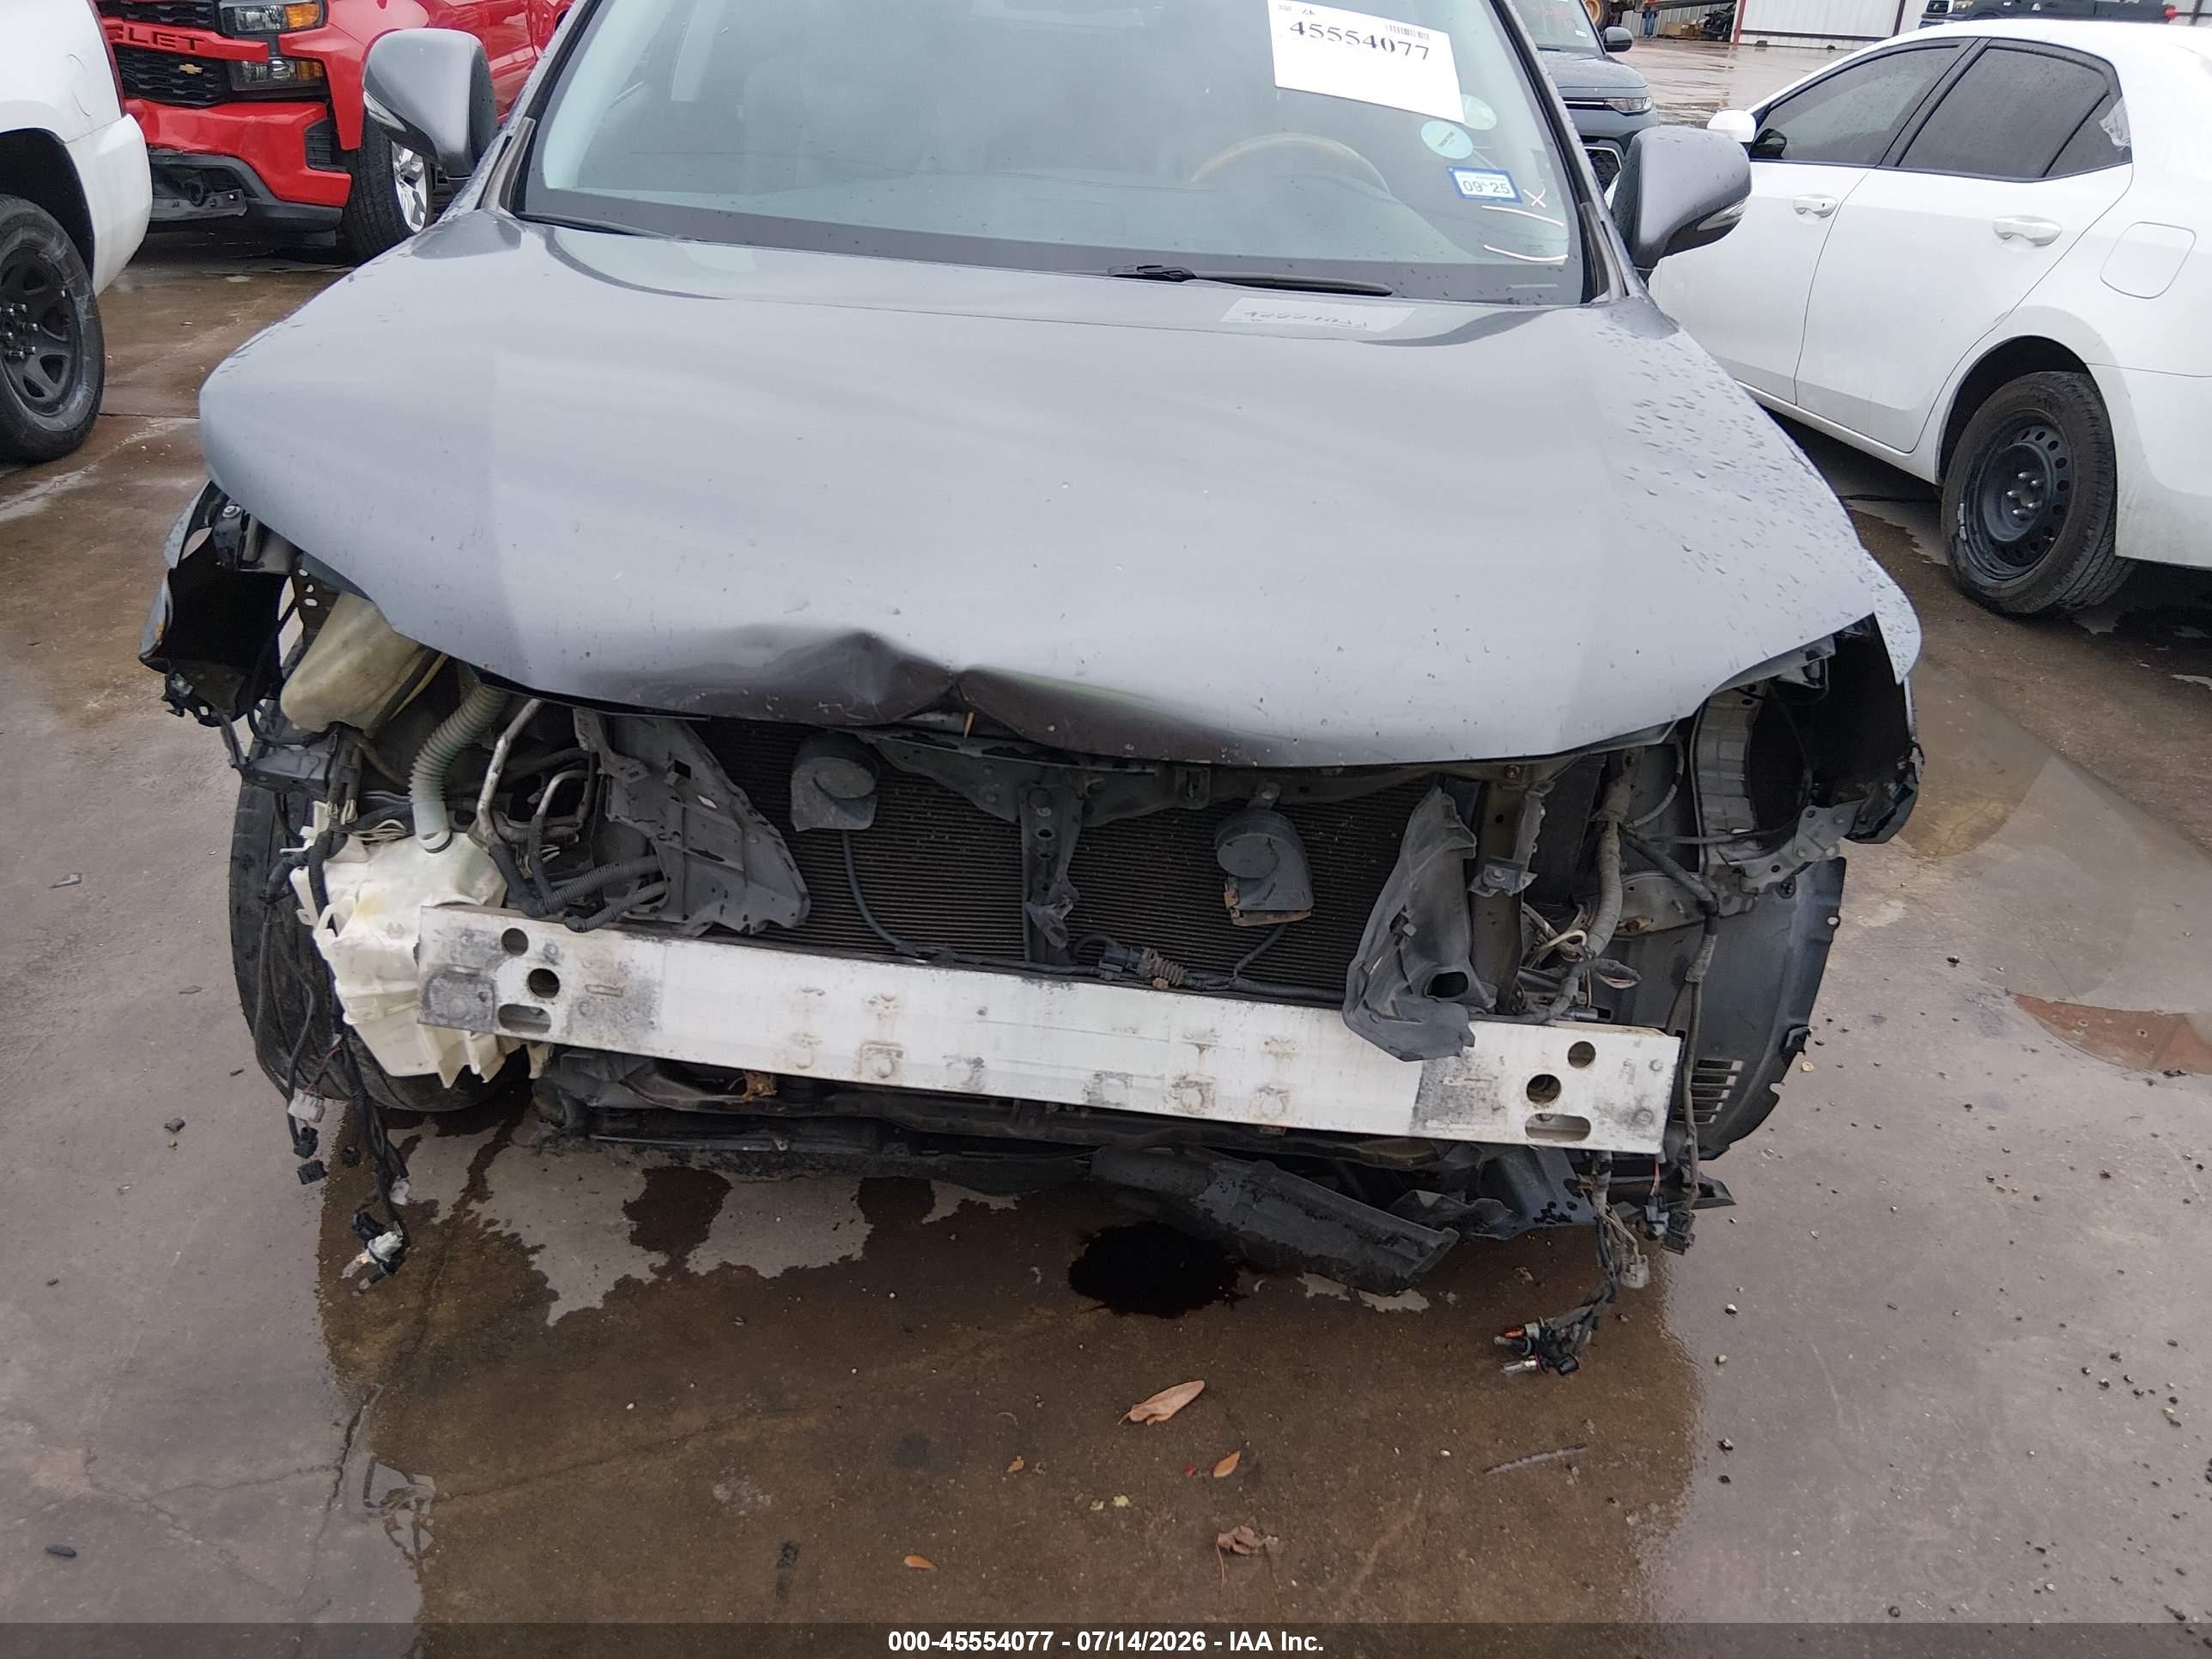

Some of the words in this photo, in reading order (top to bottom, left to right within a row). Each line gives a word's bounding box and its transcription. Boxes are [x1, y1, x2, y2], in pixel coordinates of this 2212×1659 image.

[1289, 21, 1430, 60] 45554077
[1462, 179, 1483, 192] 09
[1490, 181, 1510, 195] 25
